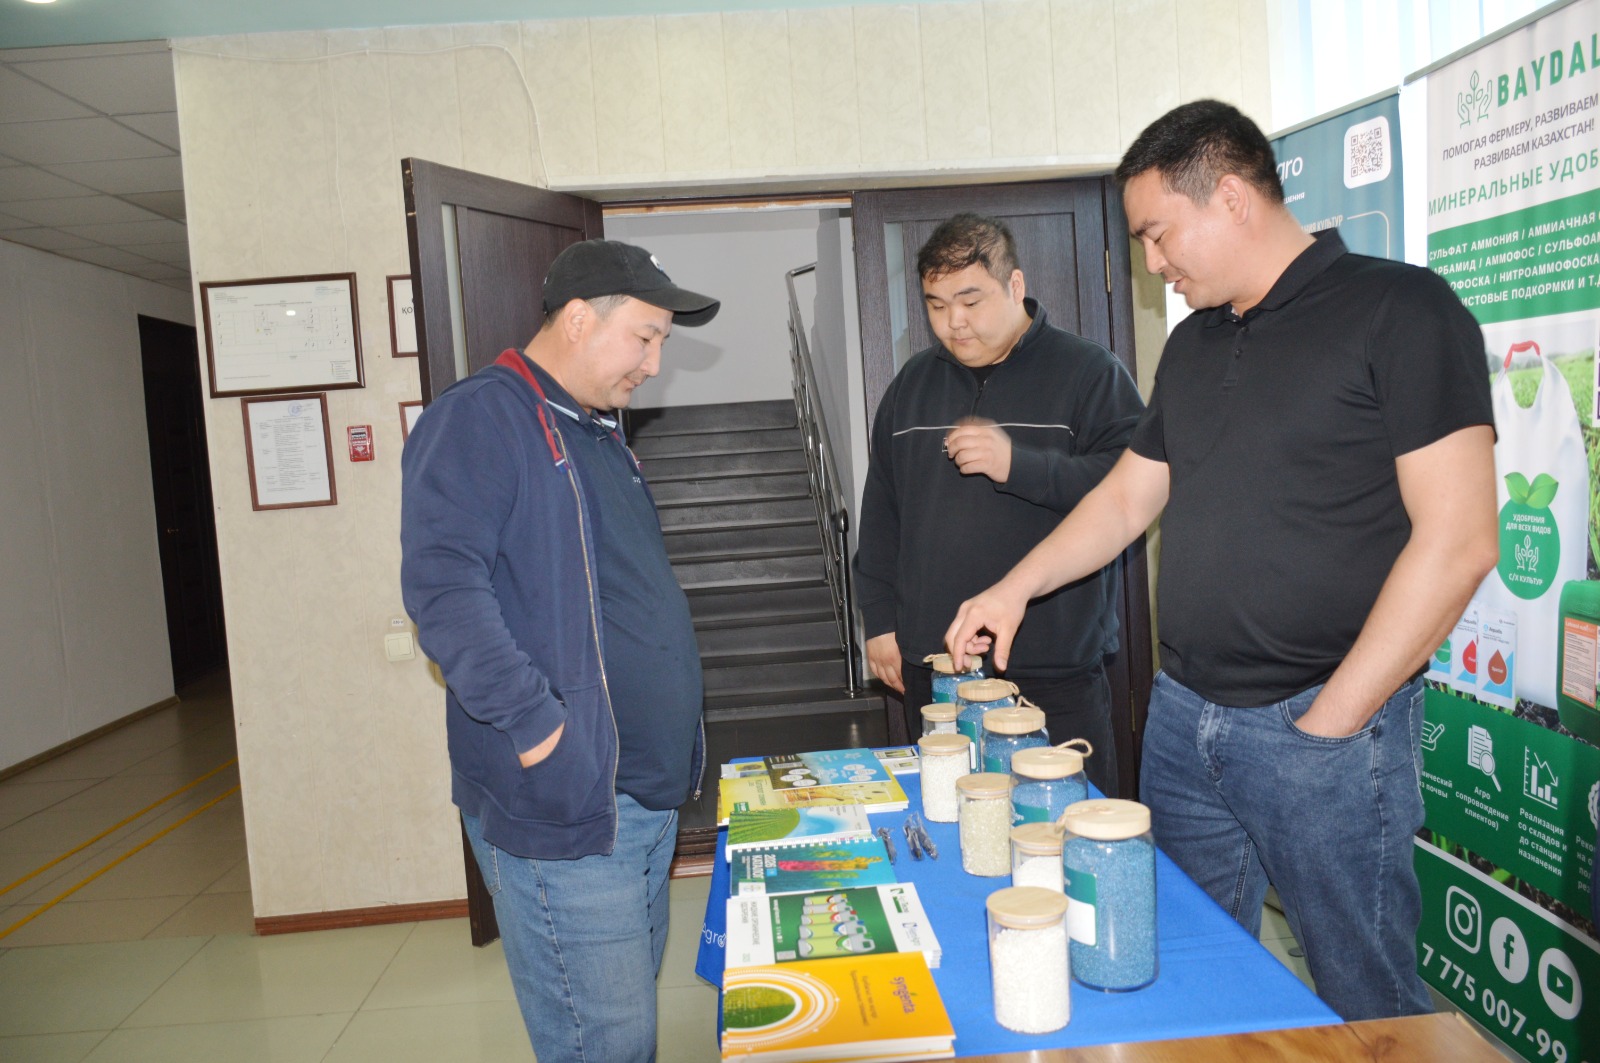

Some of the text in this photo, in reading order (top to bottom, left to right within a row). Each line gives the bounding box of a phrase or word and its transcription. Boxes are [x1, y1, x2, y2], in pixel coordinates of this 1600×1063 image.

[1497, 33, 1600, 107] BAYDAL
[1443, 93, 1599, 161] ПОМОГАЯ ФЕРМЕРУ, РАЗВИВАЕМ
[1474, 118, 1595, 170] РАЗВИВАЕМ КАЗАХСТАН!
[1428, 148, 1600, 216] МИНЕРАЛЬНЫЕ УДОБ
[1317, 215, 1343, 231] КУЛЬТУР
[1429, 243, 1468, 261] СУЛЬФАТ
[1471, 230, 1519, 252] АММОНИЯ
[1528, 212, 1596, 238] АММИАЧНАЯ
[1432, 259, 1476, 276] АРБАМИД
[1485, 247, 1535, 267] АММОФОС
[1448, 275, 1490, 292] ОФОСКА
[1499, 253, 1599, 283] НИТРОАММОФОСКА
[1511, 278, 1575, 300] ПОДКОРМКИ
[1578, 277, 1585, 289] И
[1505, 522, 1552, 535] ДЛЯ ВСЕХ ВИДОВ
[1512, 514, 1545, 524] УДОБРЕНИЯ
[1508, 573, 1543, 585] С/Х КУЛЬТУР
[1426, 784, 1448, 798] почвы
[1474, 786, 1491, 800] Агро
[1455, 791, 1509, 822] сопровождение
[1464, 807, 1499, 831] клиентов)
[1520, 807, 1564, 836] Реализация
[1518, 822, 1568, 852] со складов и
[1520, 836, 1562, 863] до станции
[1518, 848, 1562, 877] назначения
[1422, 942, 1567, 1063] 7 775 007-99
